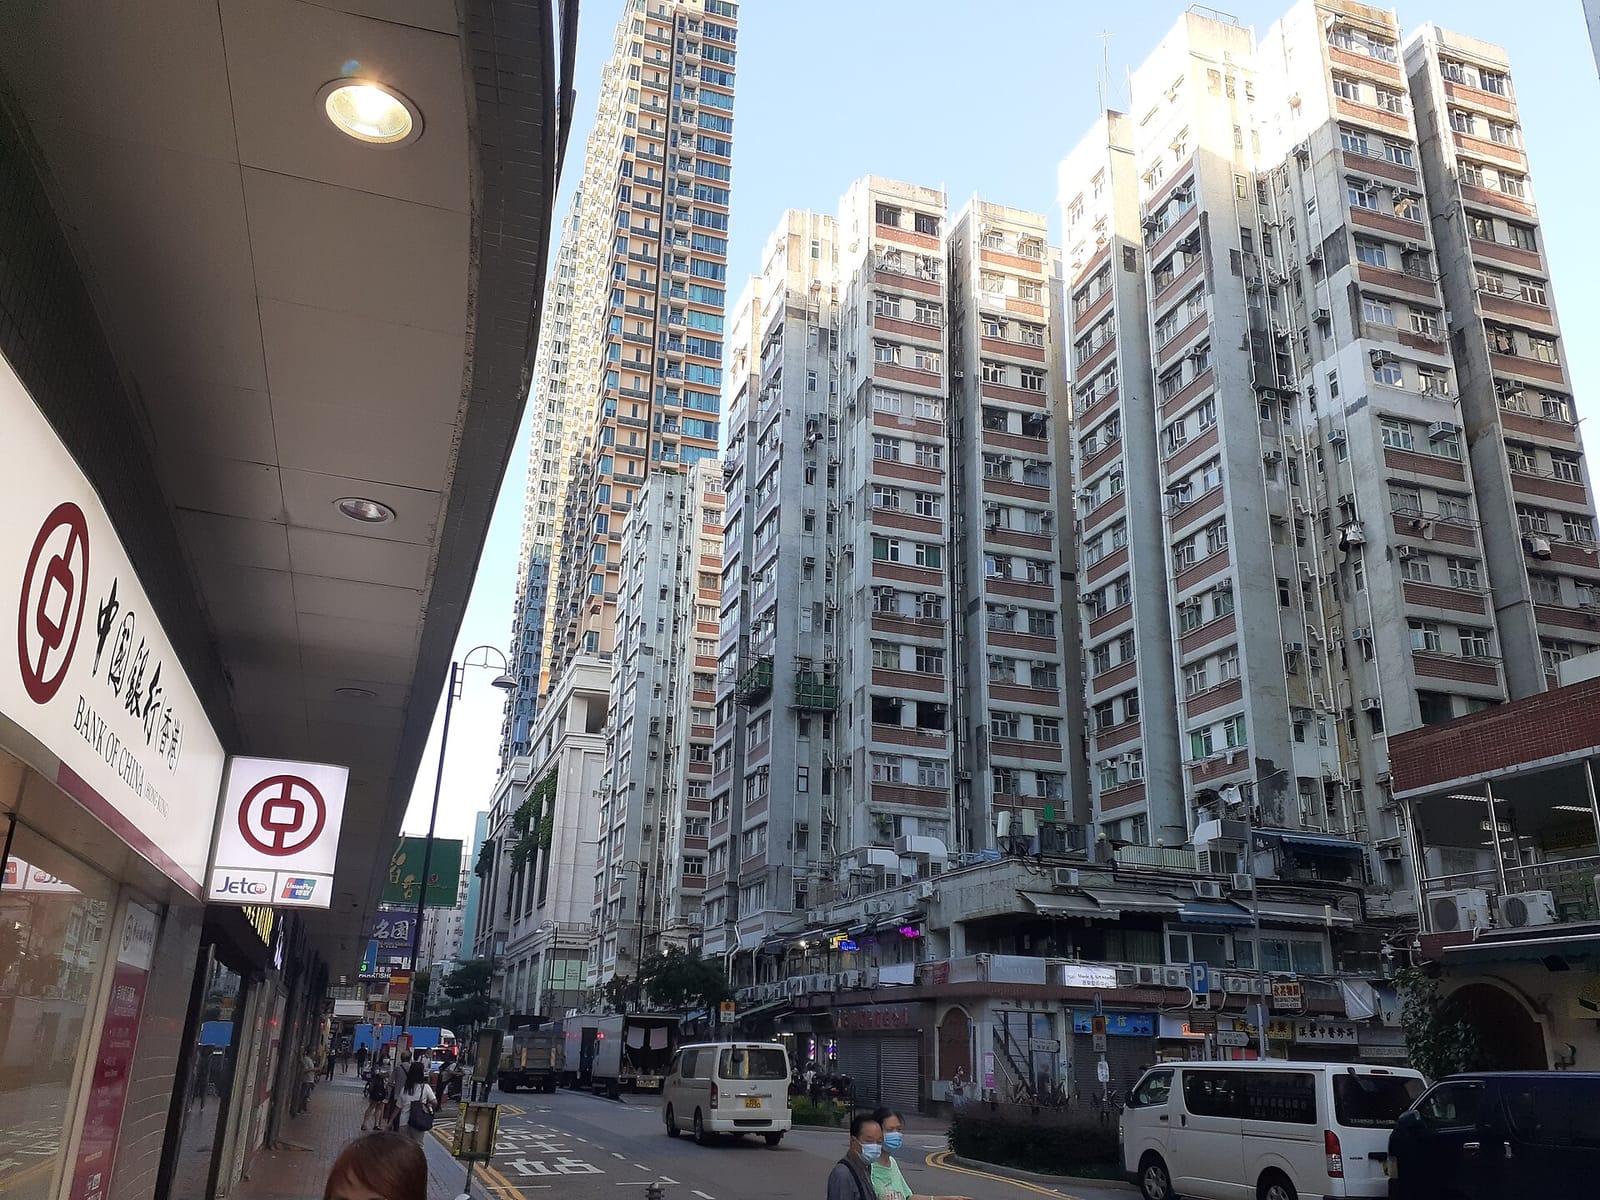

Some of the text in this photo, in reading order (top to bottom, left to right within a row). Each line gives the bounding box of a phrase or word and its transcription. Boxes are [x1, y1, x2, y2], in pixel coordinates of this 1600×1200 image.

[73, 694, 107, 756] BANK
[105, 731, 121, 770] OF
[117, 746, 146, 798] CHINA
[1193, 966, 1205, 990] P
[503, 1157, 606, 1177] 站
